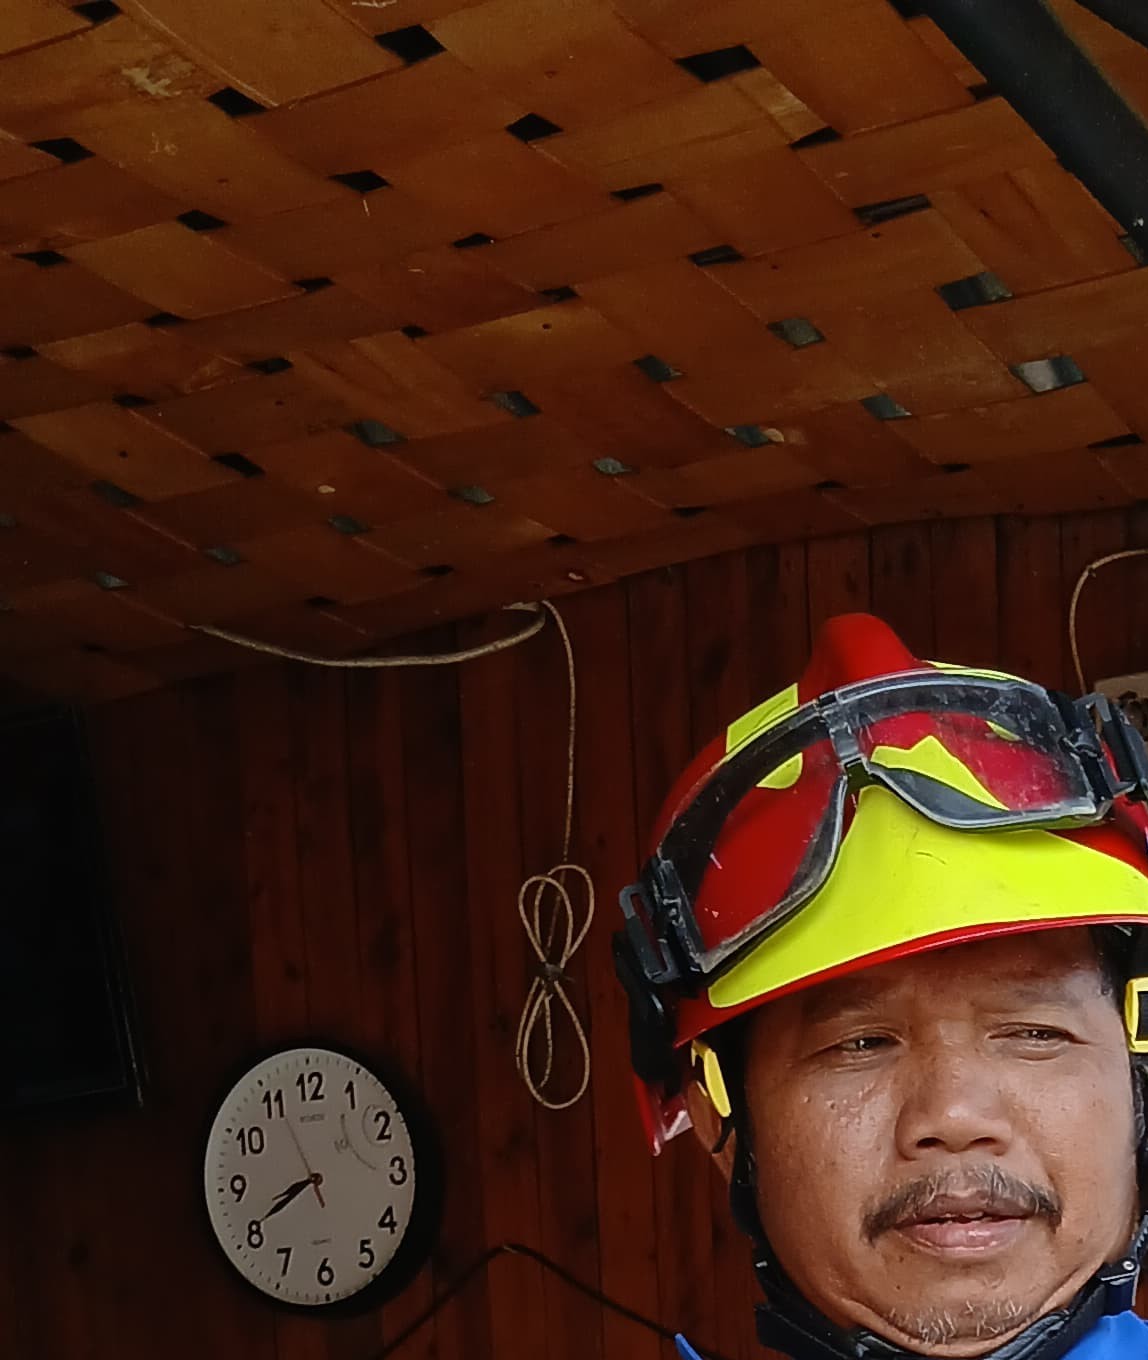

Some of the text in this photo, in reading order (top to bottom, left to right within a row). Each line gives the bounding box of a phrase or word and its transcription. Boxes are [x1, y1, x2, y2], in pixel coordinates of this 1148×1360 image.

[296, 1072, 324, 1101] 12
[345, 1080, 355, 1110] 1
[262, 1089, 284, 1119] 11
[374, 1110, 392, 1141] 2
[236, 1126, 265, 1156] 10
[389, 1156, 407, 1186] 3
[230, 1174, 247, 1202] 9
[247, 1220, 264, 1249] 8
[378, 1205, 398, 1235] 4
[276, 1247, 292, 1277] 7
[358, 1239, 375, 1268] 5
[317, 1258, 334, 1286] 6
